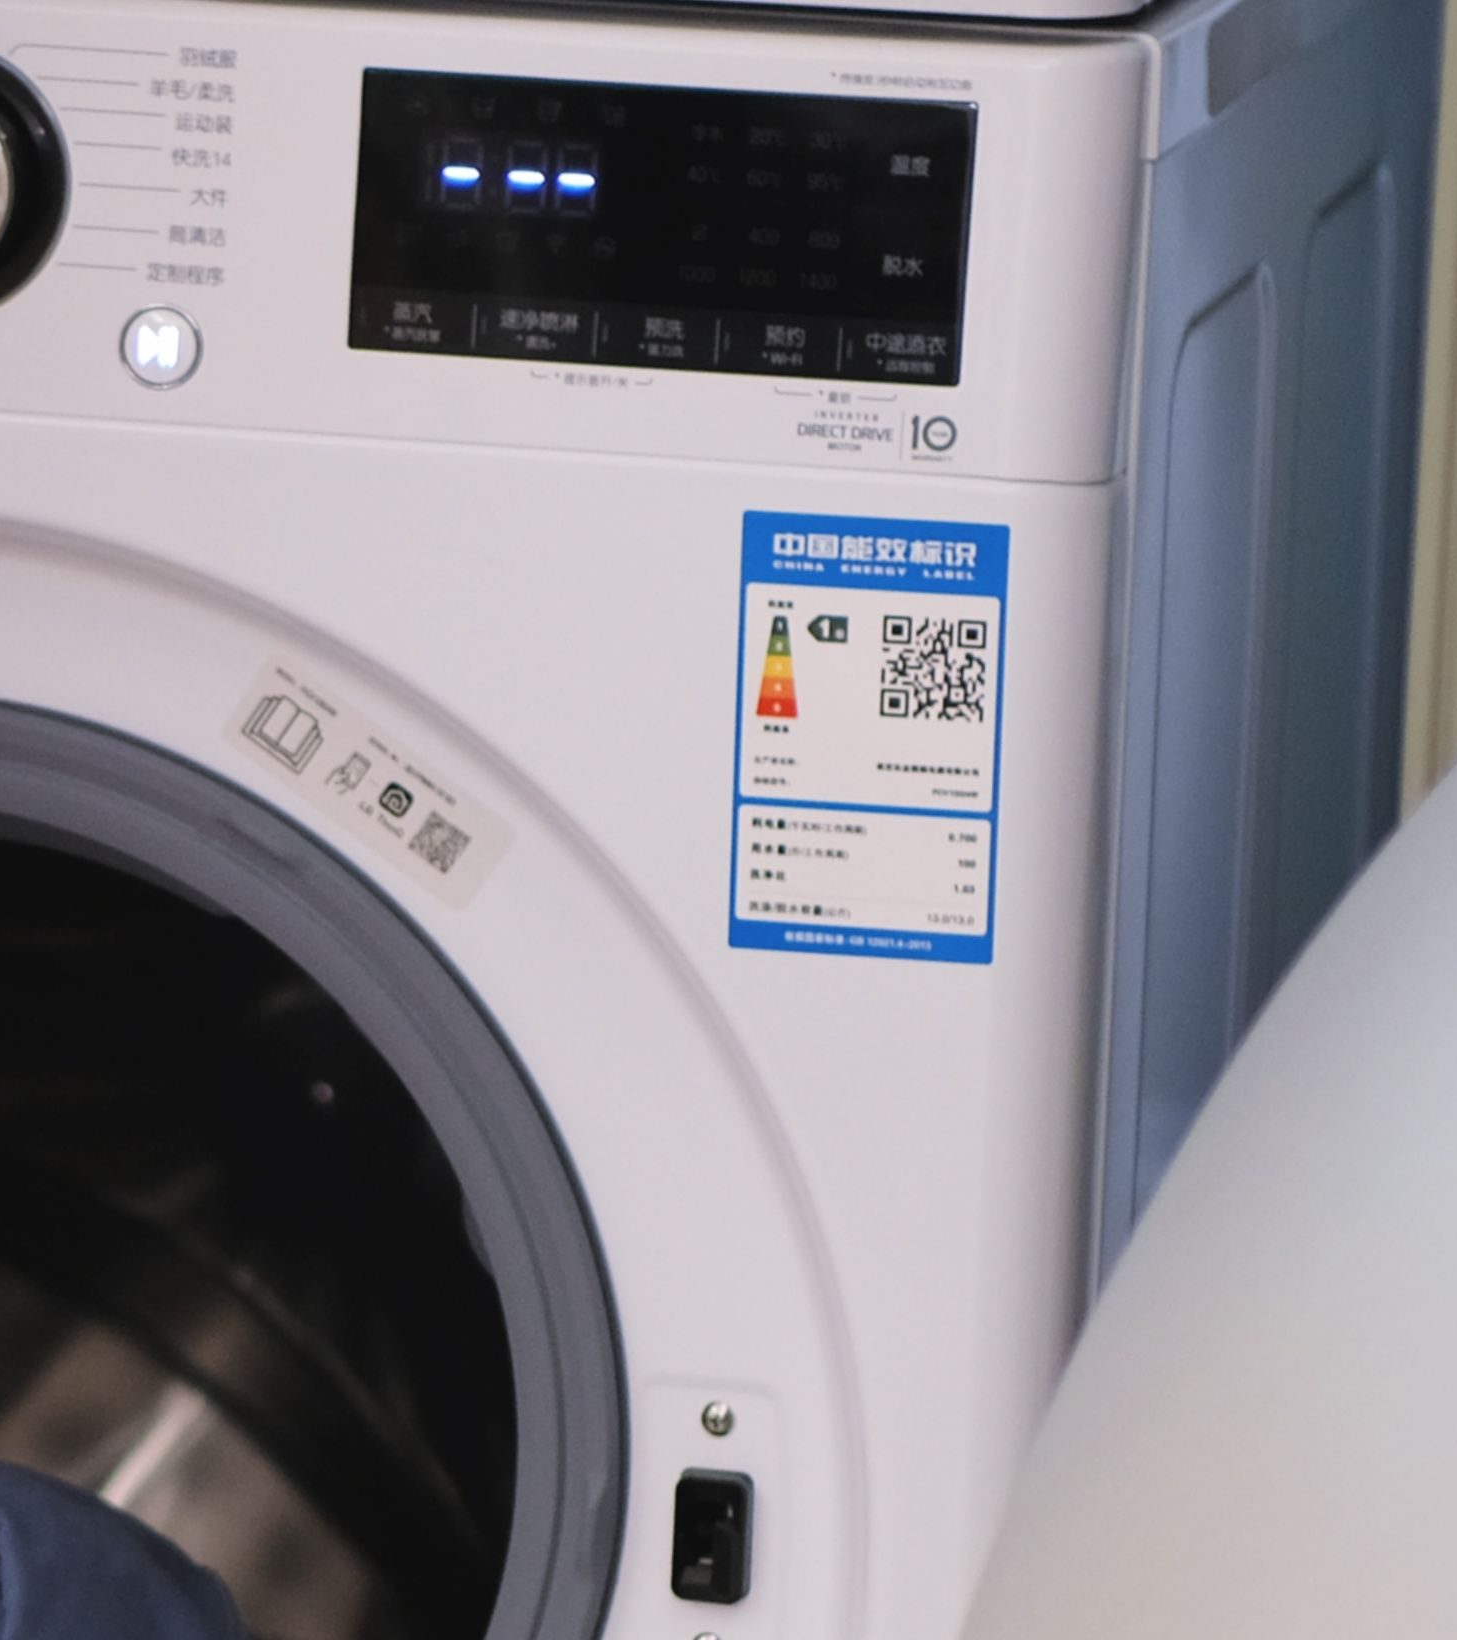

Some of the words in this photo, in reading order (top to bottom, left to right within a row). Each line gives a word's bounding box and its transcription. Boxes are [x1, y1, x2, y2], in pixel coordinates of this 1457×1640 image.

[148, 79, 236, 104] 羊毛/柔洗
[175, 111, 233, 135] 运动装
[172, 147, 232, 169] 快洗14
[889, 153, 931, 178] 温度
[190, 187, 229, 209] 大件
[147, 261, 226, 287] 定制程序
[881, 253, 925, 277] 脱水
[392, 302, 433, 324] 蒸汽
[499, 308, 579, 334] 速净喷淋
[645, 317, 685, 341] 预洗
[765, 324, 806, 349] 预约
[865, 332, 947, 357] 中途添衣
[797, 422, 847, 440] DIRECT
[851, 426, 894, 443] DRIVE
[772, 532, 977, 568] 中国能效标识
[772, 559, 825, 572] CHINA
[840, 563, 907, 577] ENERGY
[923, 568, 975, 580] LABEL
[818, 618, 830, 640] 1
